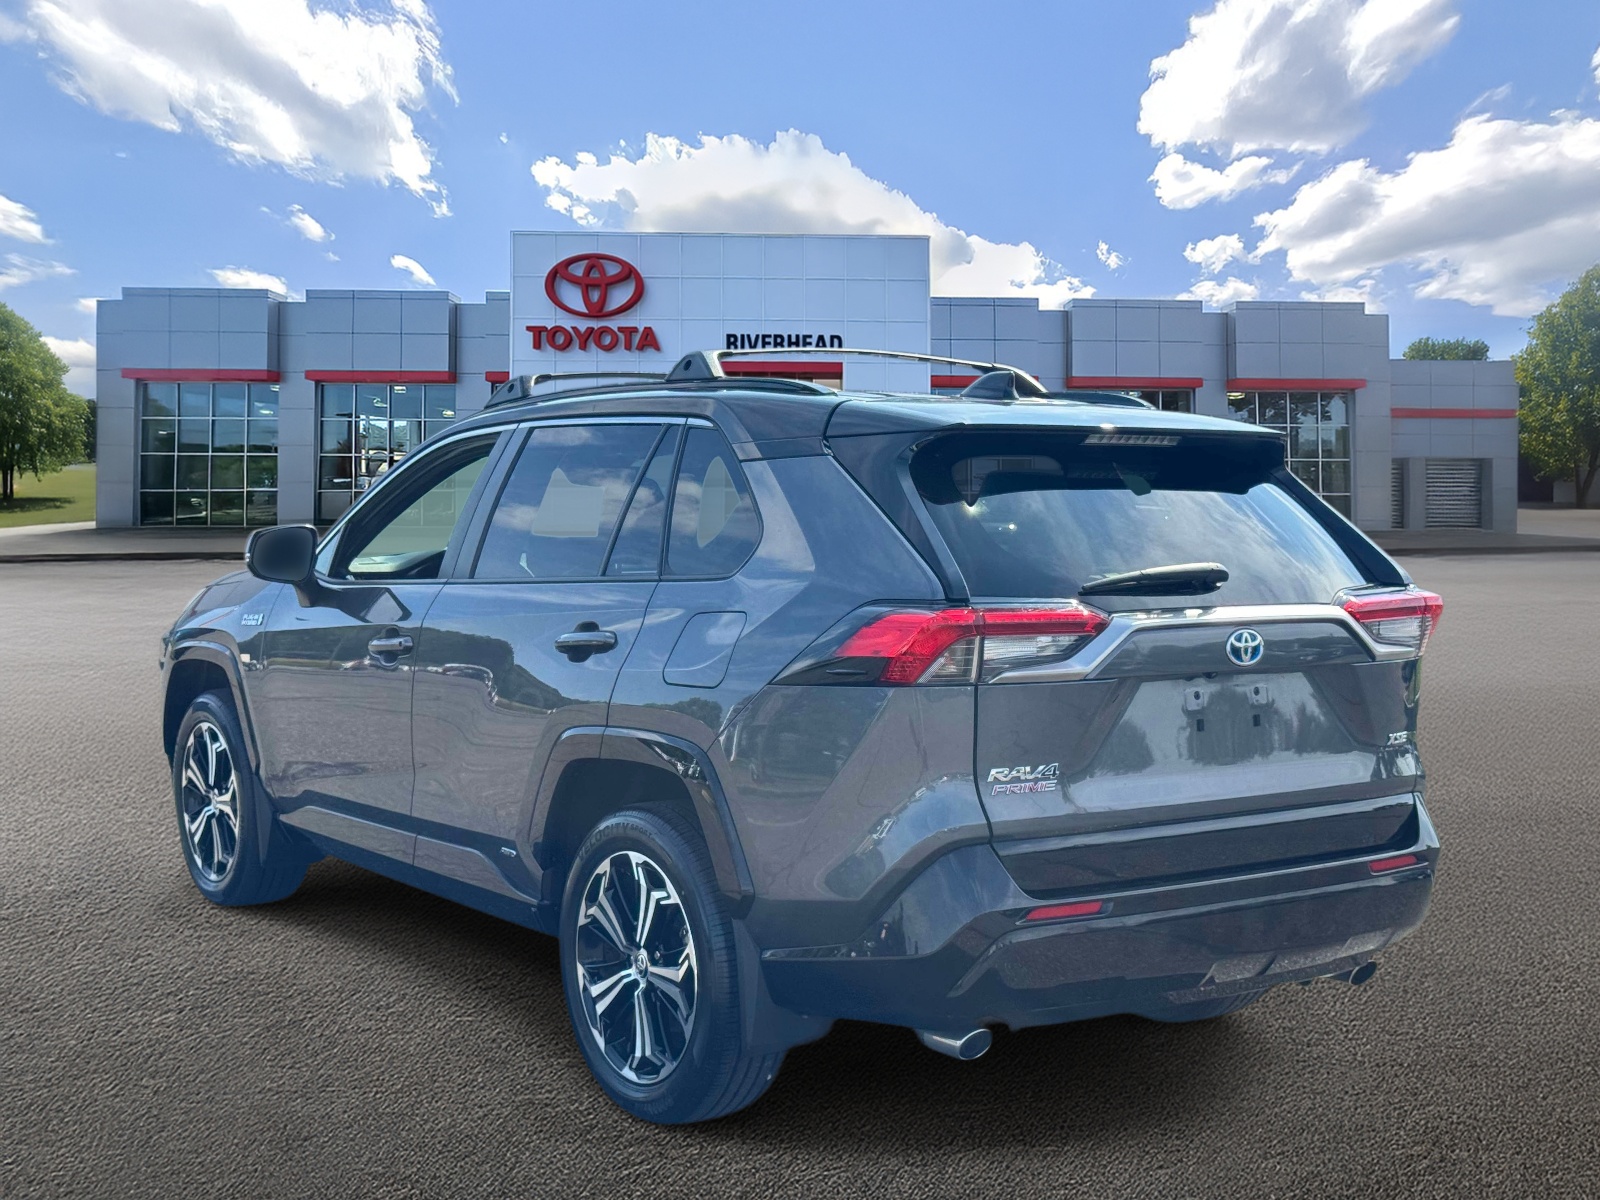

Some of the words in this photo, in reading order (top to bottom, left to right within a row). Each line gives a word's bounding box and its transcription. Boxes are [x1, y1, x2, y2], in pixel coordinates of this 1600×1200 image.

[525, 325, 661, 352] TOYOTA
[726, 333, 843, 350] RIVERHEAD
[987, 763, 1059, 782] RAV4
[991, 780, 1058, 796] PRIME
